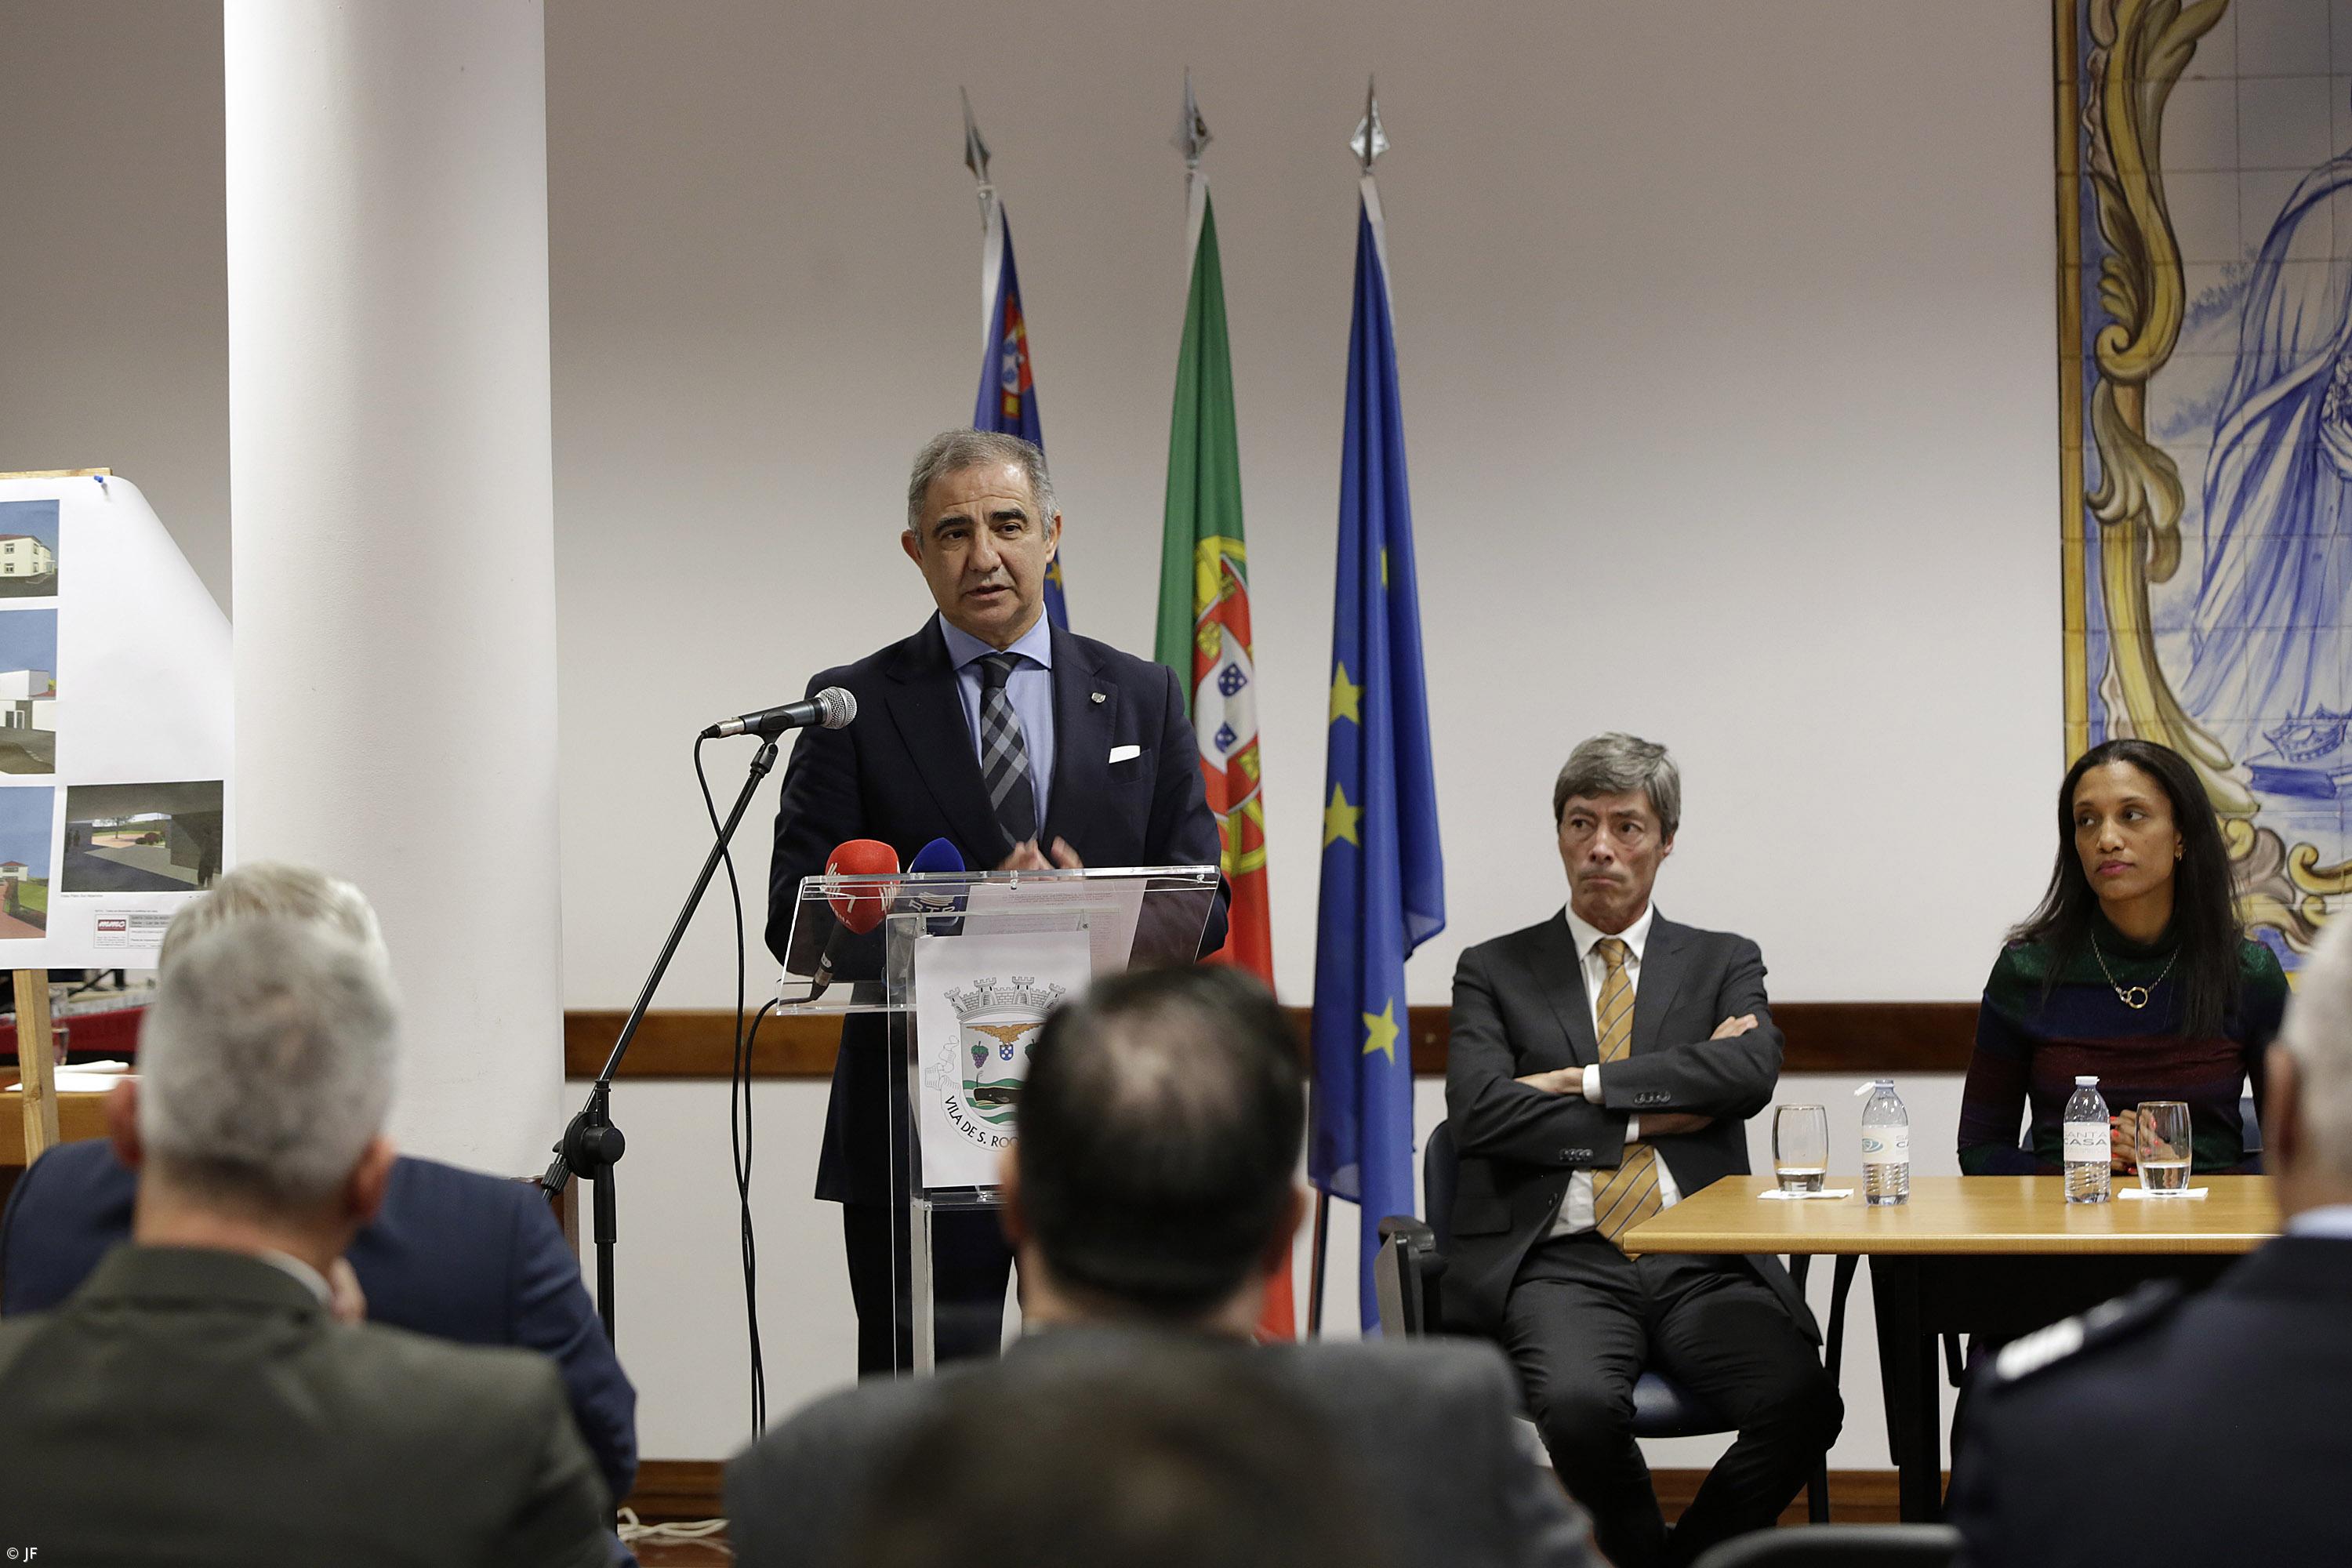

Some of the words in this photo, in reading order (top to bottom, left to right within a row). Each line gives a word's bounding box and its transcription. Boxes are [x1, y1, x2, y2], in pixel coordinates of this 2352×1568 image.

[945, 1095, 963, 1125] VILA
[960, 1121, 978, 1138] DE
[977, 1131, 986, 1144] S.
